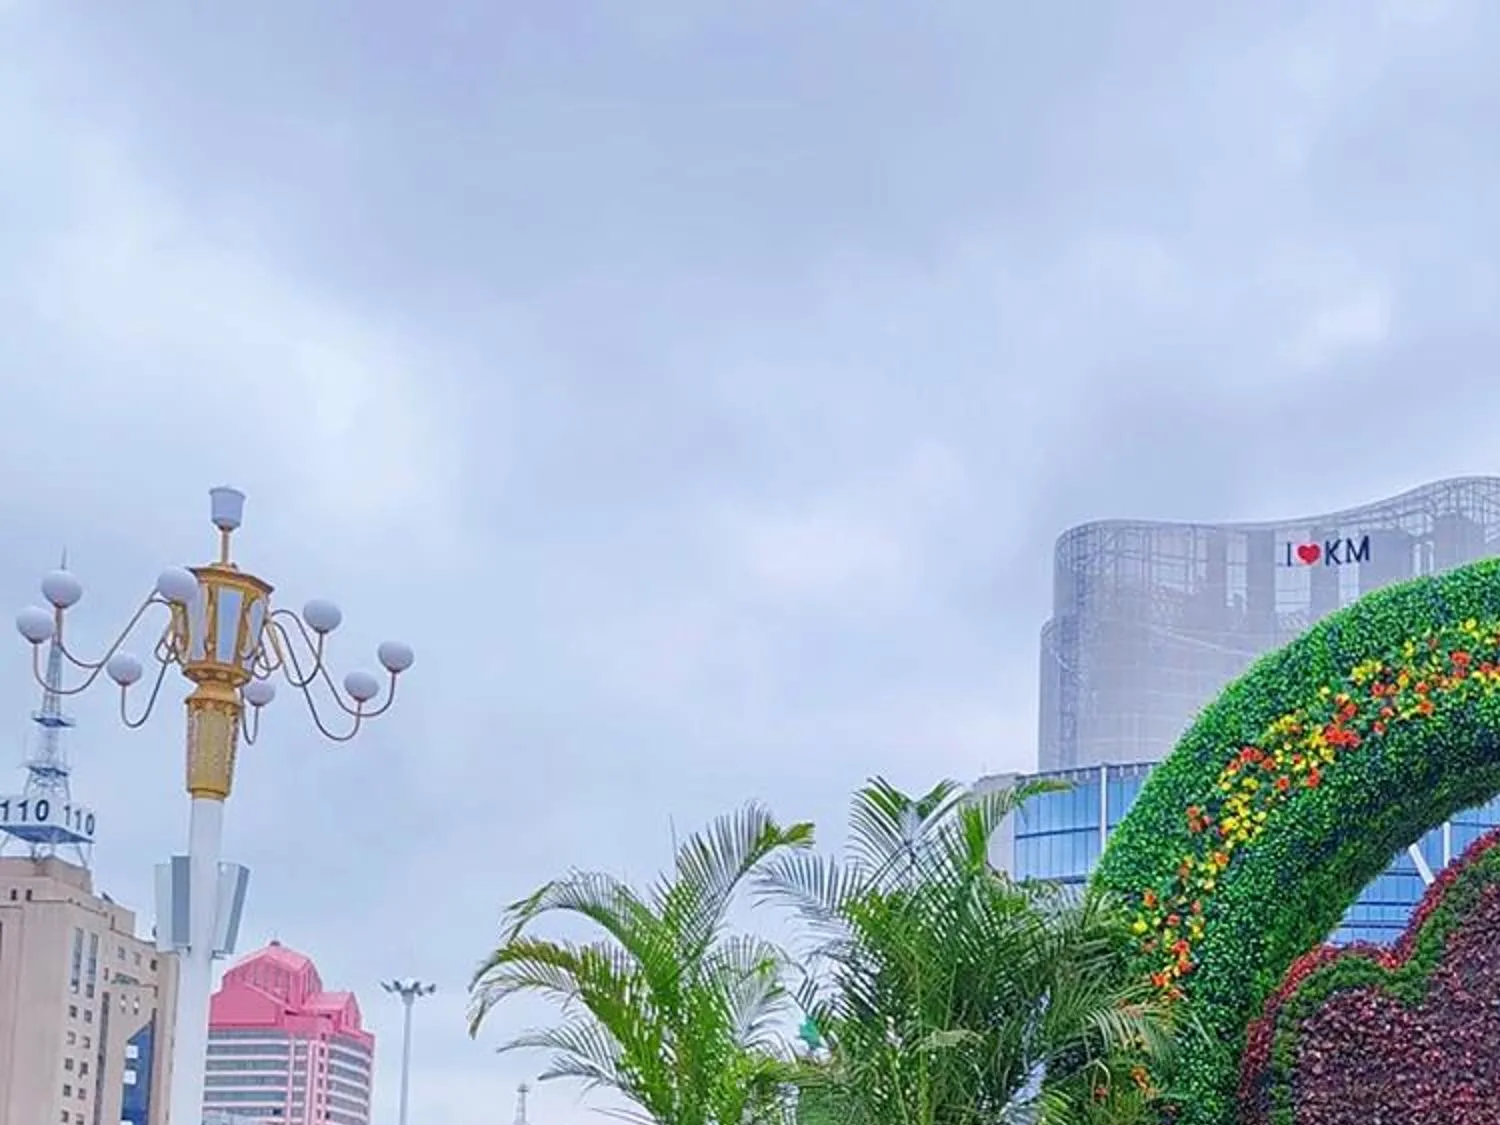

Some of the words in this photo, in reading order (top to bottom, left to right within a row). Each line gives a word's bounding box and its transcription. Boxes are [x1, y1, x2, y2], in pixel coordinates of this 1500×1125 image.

[1325, 535, 1371, 567] KM
[0, 799, 49, 822] 110
[64, 804, 95, 836] 110
